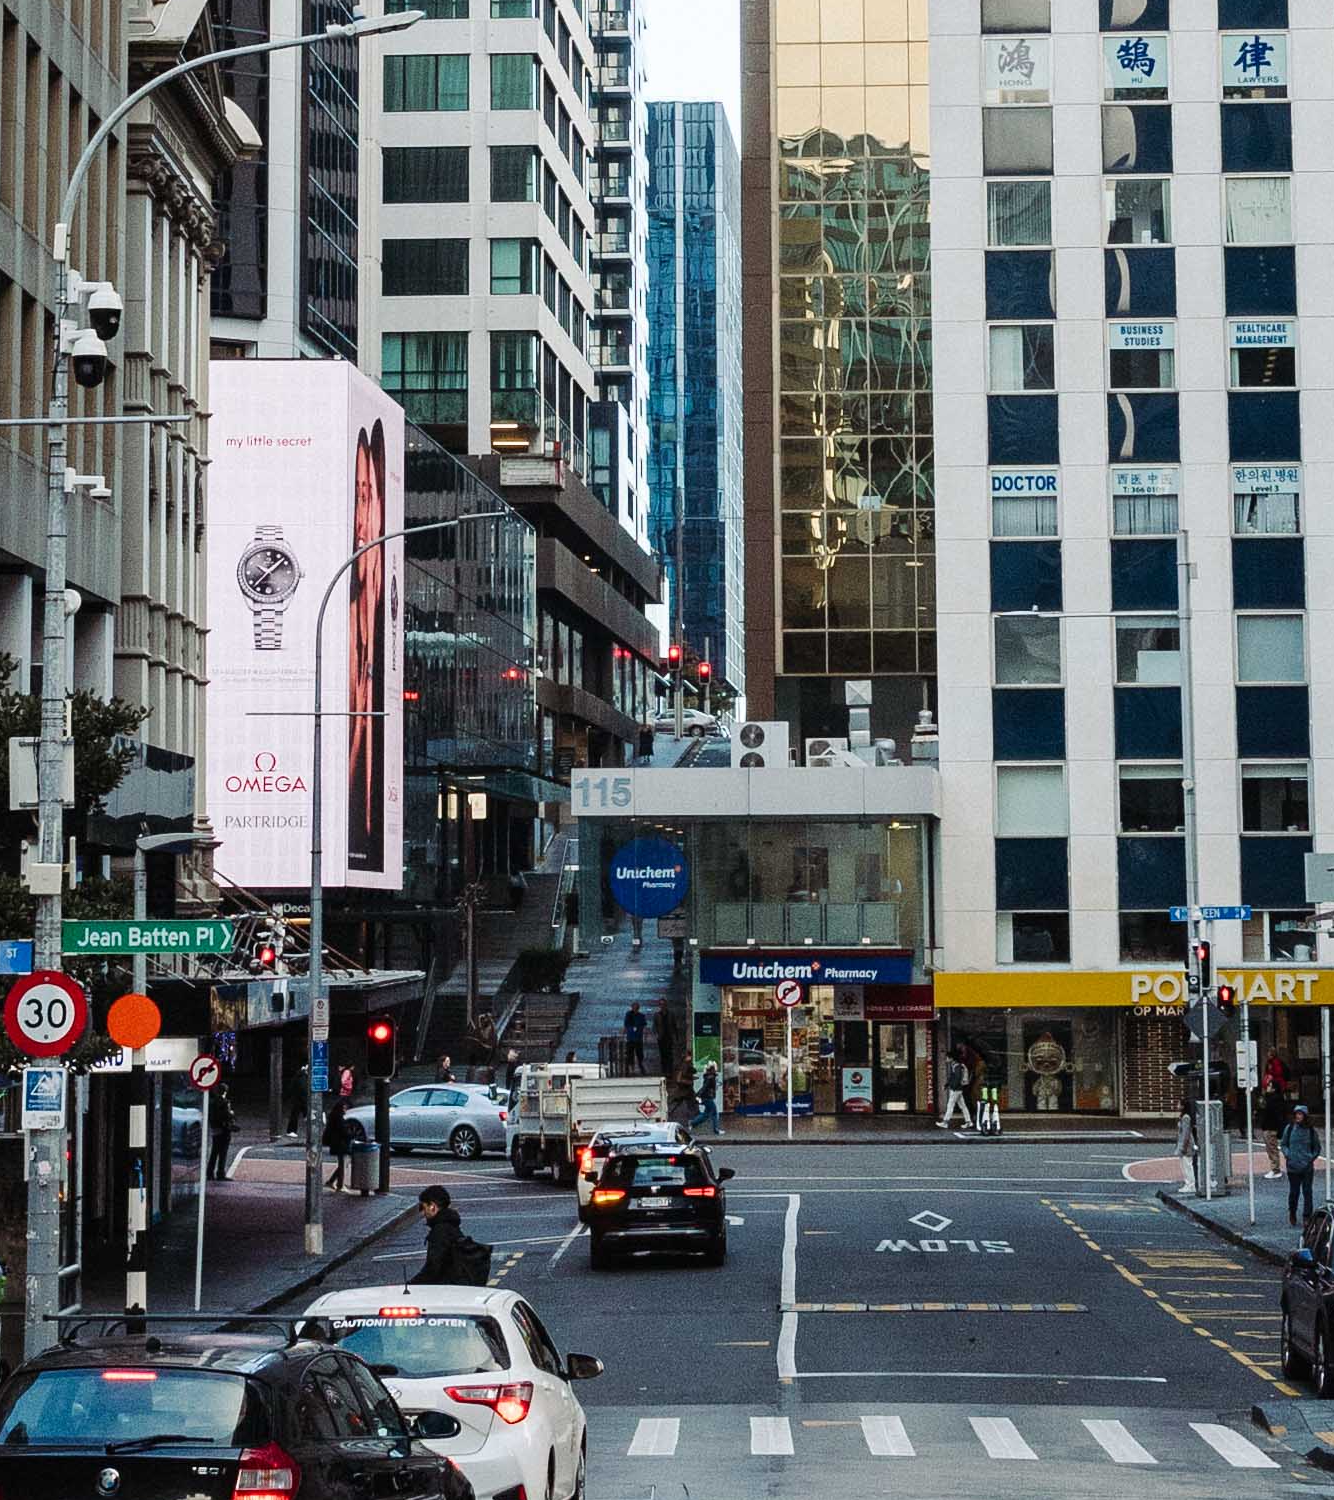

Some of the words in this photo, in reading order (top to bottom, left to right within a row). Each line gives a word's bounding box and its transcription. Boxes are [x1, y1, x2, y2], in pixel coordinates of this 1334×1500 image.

[1233, 35, 1274, 78] 律
[1131, 76, 1144, 85] HU
[1237, 75, 1280, 85] LAWYERS
[1119, 324, 1164, 335] BUSINESS
[1236, 323, 1287, 334] HEALTHCARE
[1124, 336, 1162, 347] STUDIES
[1235, 334, 1288, 345] MANAGEMENT
[226, 436, 243, 448] my
[246, 434, 273, 447] little
[277, 435, 312, 447] secret
[991, 475, 1057, 492] DOCTOR
[1250, 485, 1273, 493] Level
[225, 775, 307, 792] OMEGA
[575, 777, 631, 808] 115
[224, 815, 308, 828] PARTRIDGE
[617, 865, 676, 880] Unichem
[642, 881, 676, 890] Pharmacy
[78, 926, 122, 948] Jean
[129, 926, 193, 947] Batten
[196, 927, 214, 947] Pl
[6, 947, 18, 959] ST
[733, 961, 812, 979] Unichem
[824, 967, 878, 981] Pharmacy
[1217, 973, 1319, 1003] MART
[24, 998, 67, 1029] 30
[1156, 1006, 1185, 1017] MAR
[332, 1318, 387, 1329] CAUTION!
[395, 1318, 427, 1328] STOP
[428, 1318, 467, 1328] OFTEN
